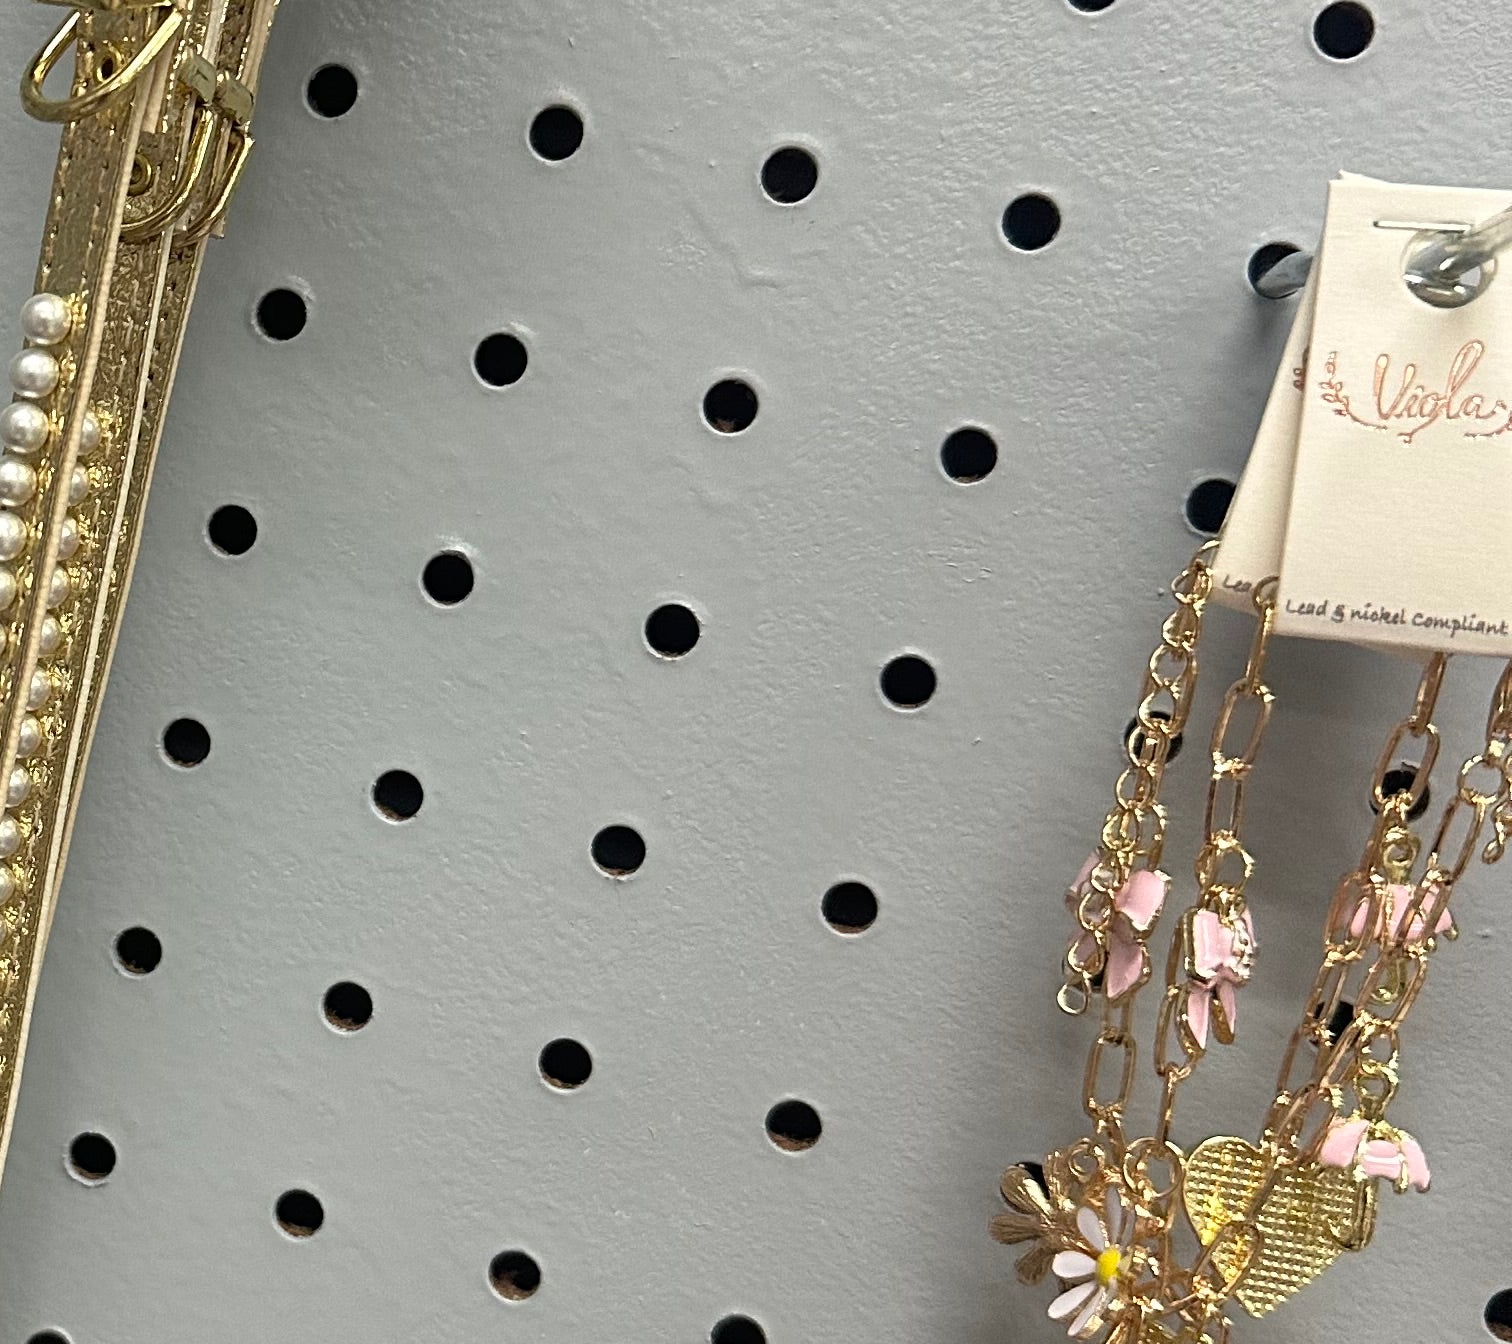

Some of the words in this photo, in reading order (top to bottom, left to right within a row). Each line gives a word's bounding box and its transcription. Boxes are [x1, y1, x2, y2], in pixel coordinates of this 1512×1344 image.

[1373, 339, 1497, 444] Viola
[1285, 599, 1328, 618] Lead
[1350, 602, 1407, 626] nickel
[1411, 612, 1509, 638] Compliant
